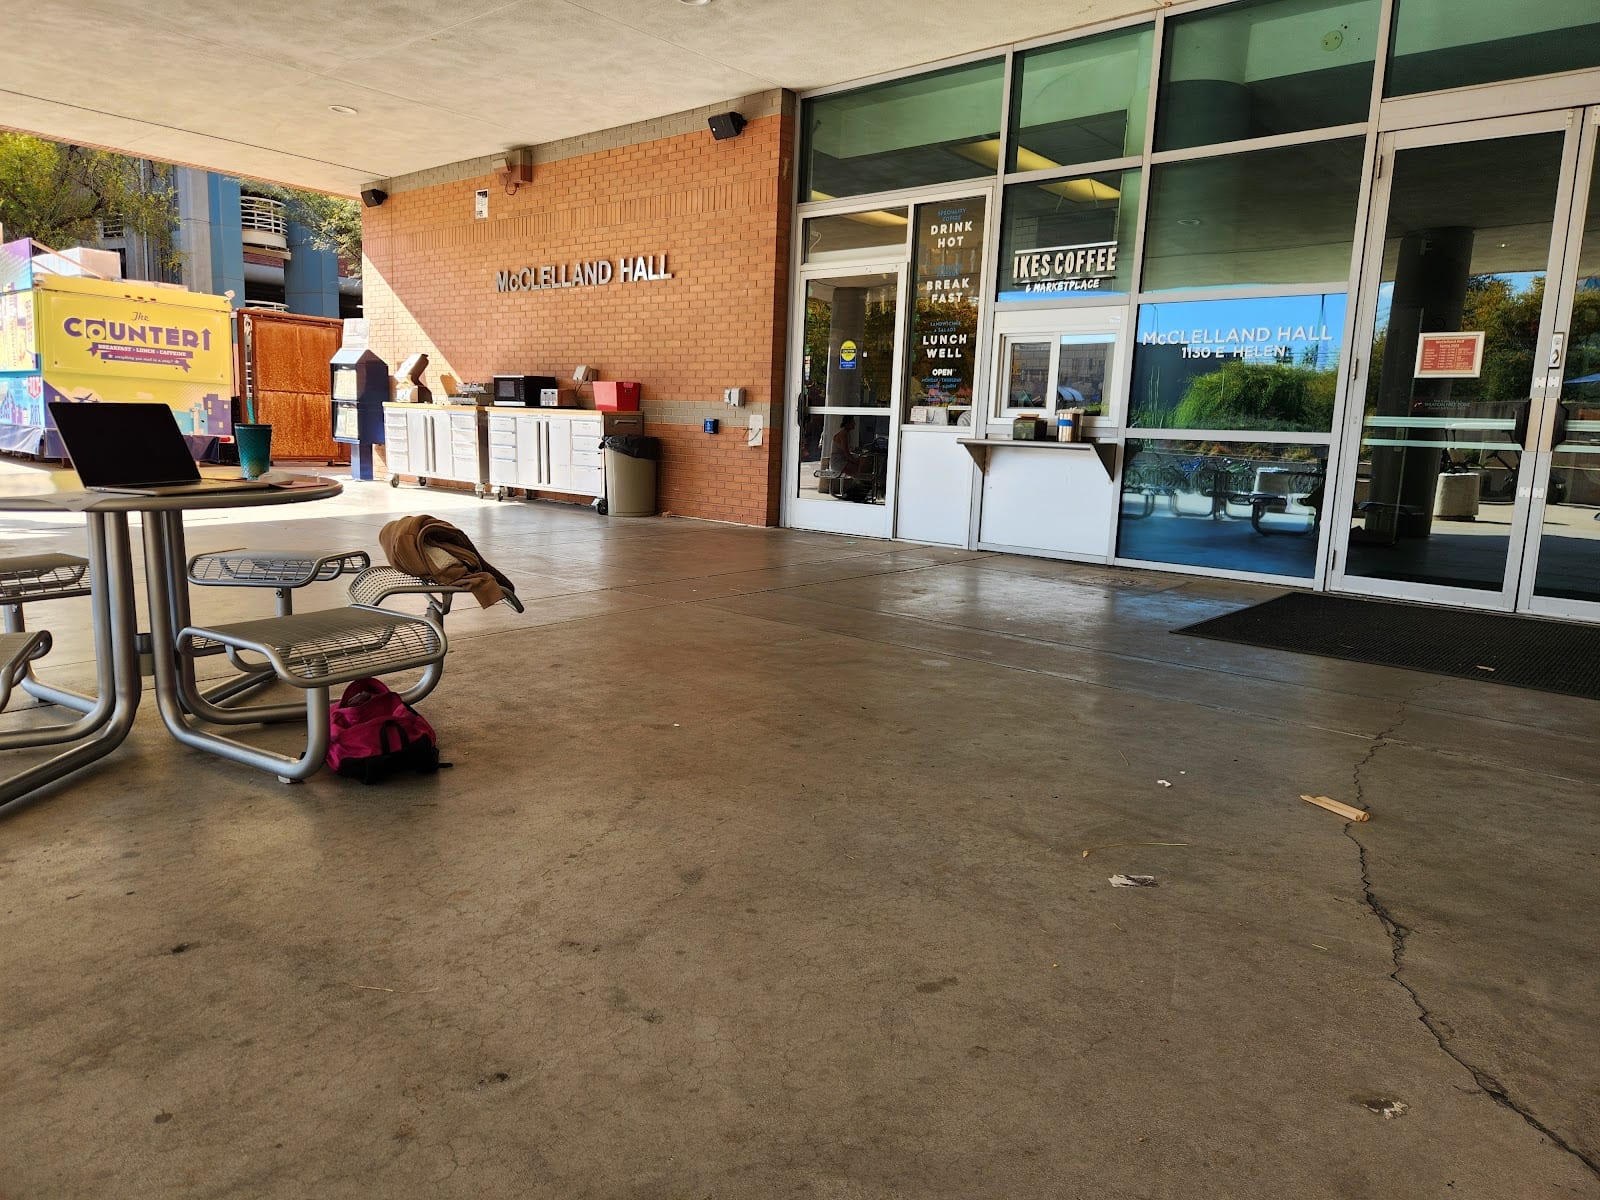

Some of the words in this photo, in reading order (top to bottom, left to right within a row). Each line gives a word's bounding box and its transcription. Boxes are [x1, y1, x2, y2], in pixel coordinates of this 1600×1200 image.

[930, 220, 973, 236] DRINK
[937, 236, 964, 249] HOT
[1013, 253, 1051, 279] IKES
[1054, 247, 1117, 275] COFFEE
[496, 260, 613, 293] McCLELLAND
[619, 253, 674, 283] HALL
[926, 277, 970, 291] BREAK
[1033, 279, 1100, 293] MARKETPLACE
[931, 292, 963, 304] FAST
[132, 311, 150, 322] The
[63, 316, 200, 349] COUNTER
[922, 333, 967, 346] LUNCH
[1143, 327, 1276, 345] McCLELLAND
[1277, 325, 1333, 342] HALL
[98, 344, 132, 352] BREAKFAST
[926, 347, 962, 359] WELL
[1181, 346, 1211, 359] 1130
[1215, 346, 1225, 358] E
[1233, 345, 1286, 358] HELEN
[932, 368, 953, 376] OPEN
